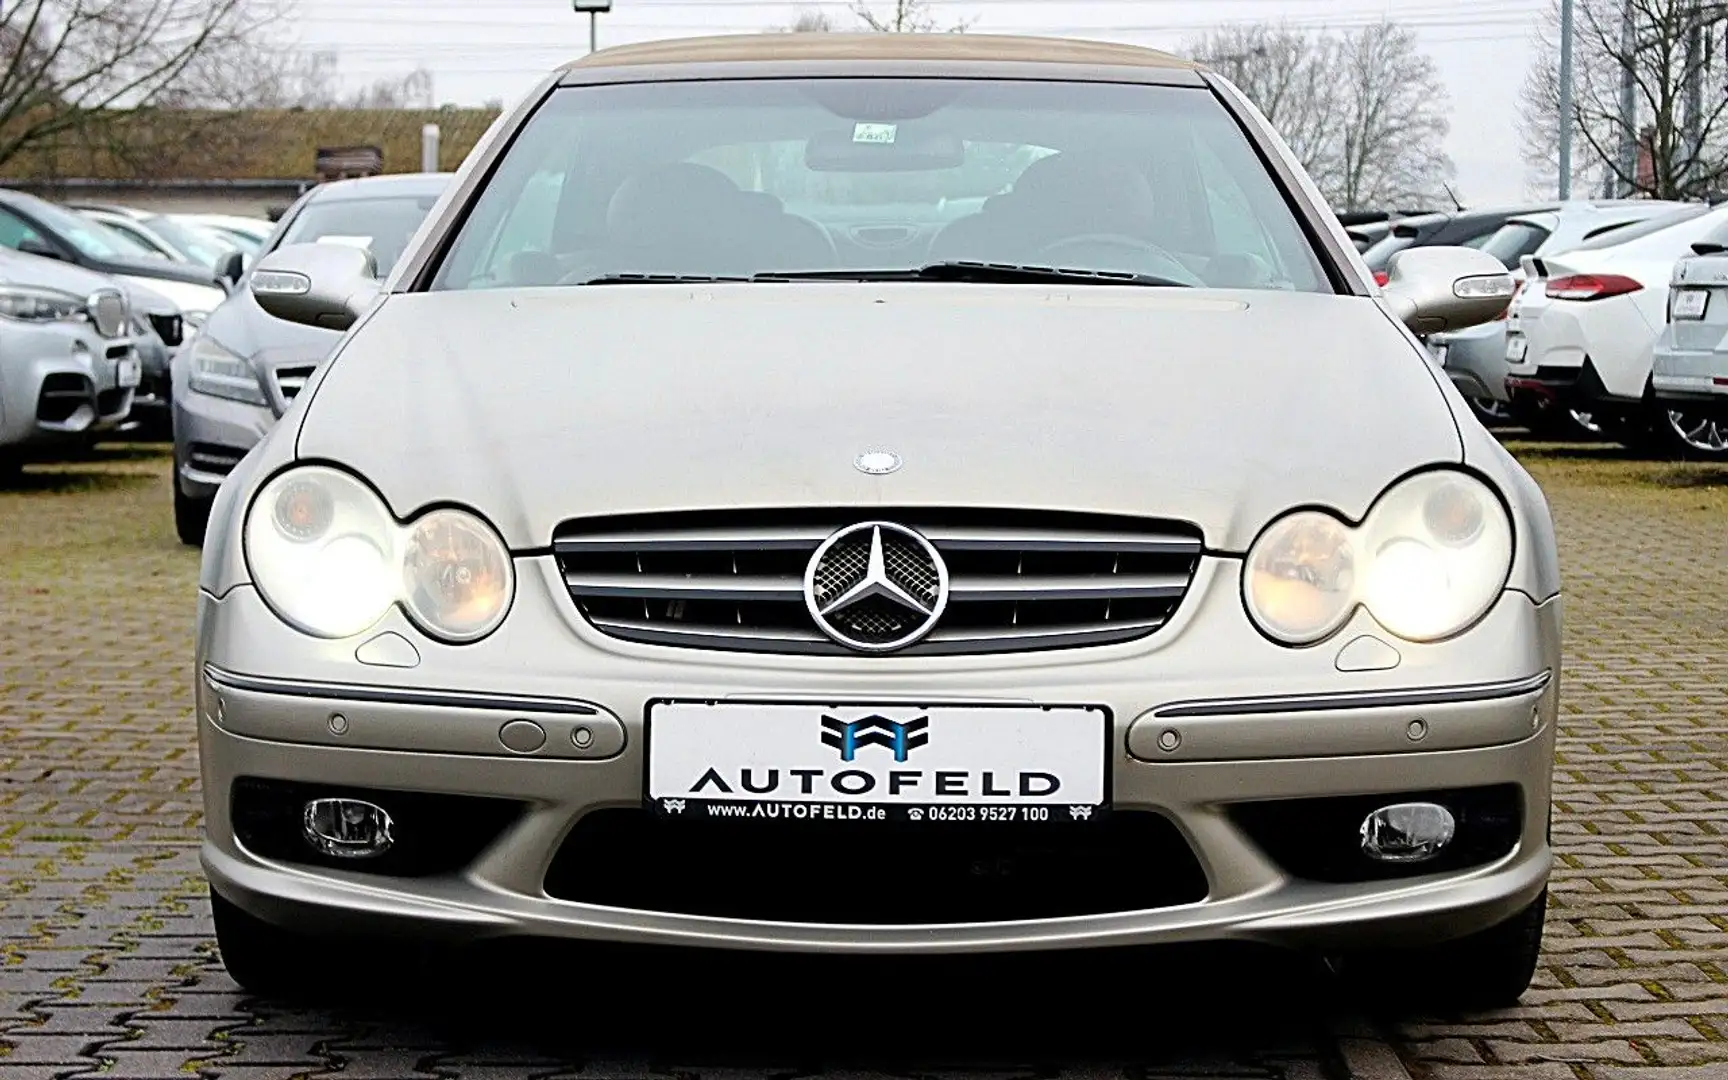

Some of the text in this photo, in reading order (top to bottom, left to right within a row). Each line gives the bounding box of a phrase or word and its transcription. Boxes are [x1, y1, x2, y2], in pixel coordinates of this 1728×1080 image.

[689, 767, 1061, 797] AUTOFELD
[707, 803, 1049, 821] www.AUTOFELD.de 06203 9527 100
